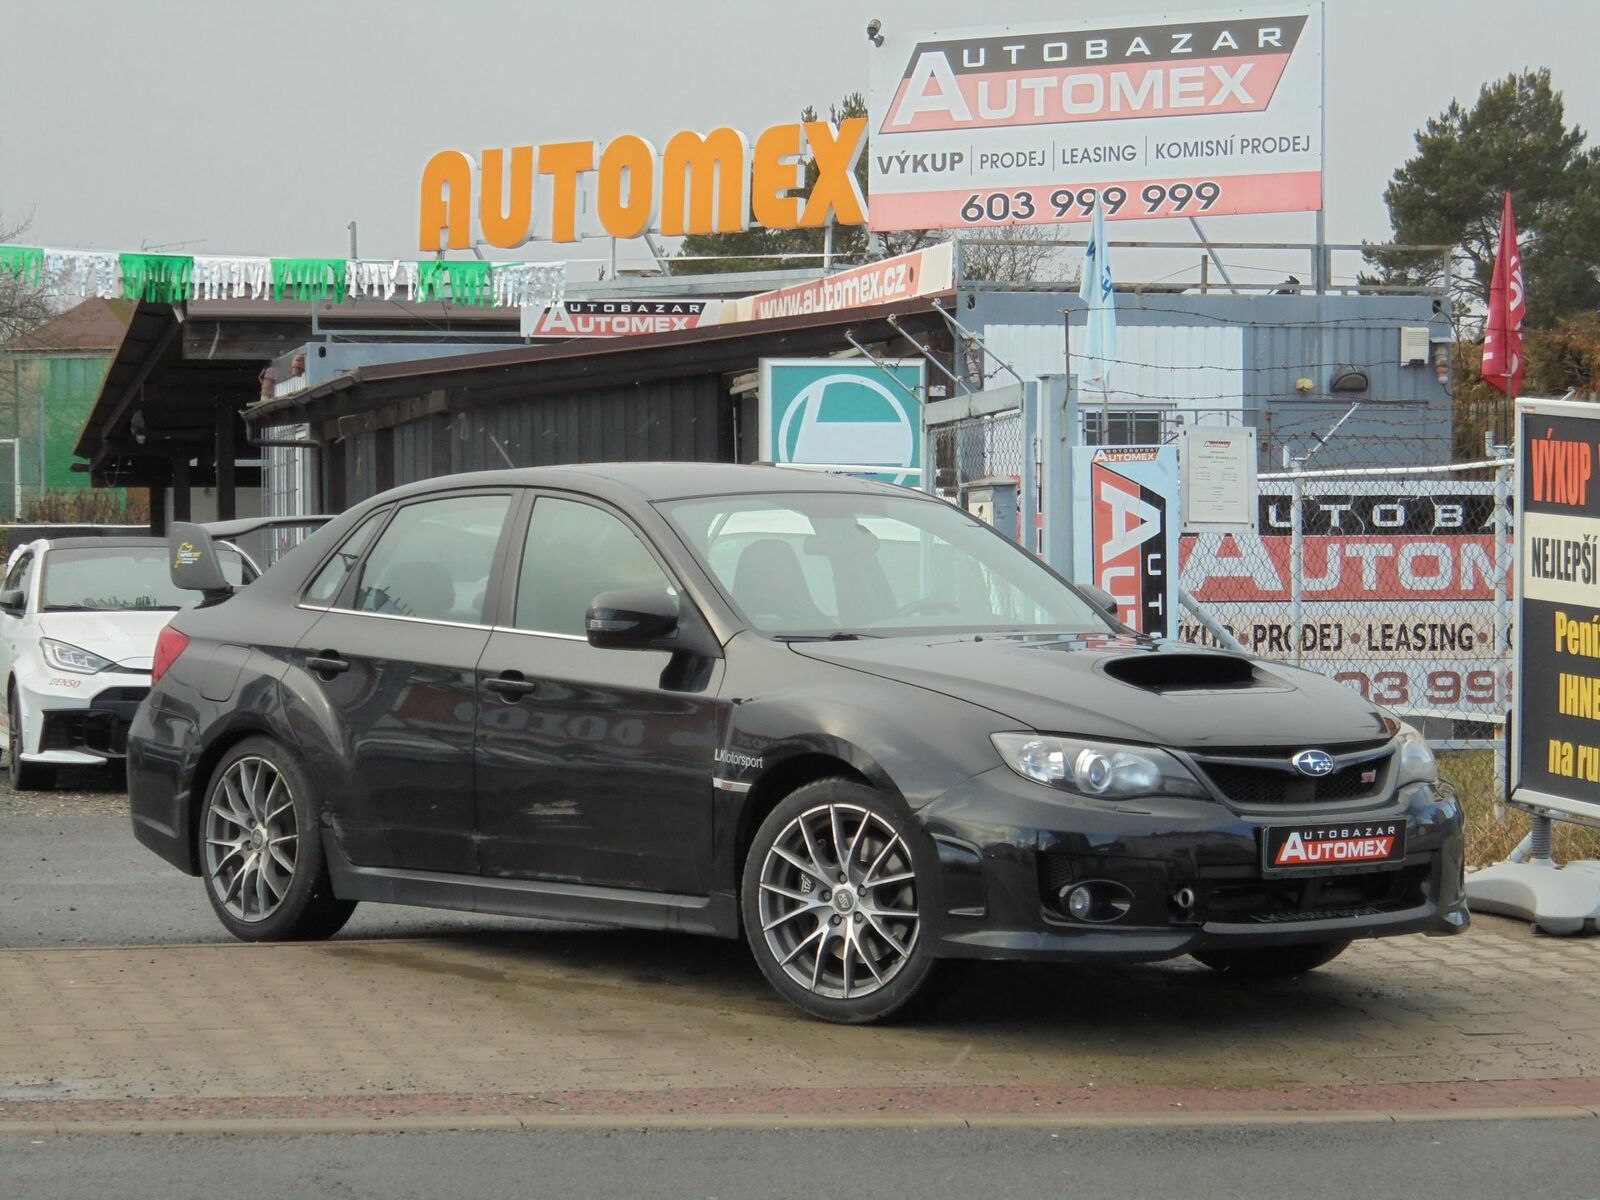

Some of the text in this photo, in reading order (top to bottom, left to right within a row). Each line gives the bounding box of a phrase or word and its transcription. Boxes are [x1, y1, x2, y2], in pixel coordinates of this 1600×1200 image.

[891, 50, 1255, 126] AUTOMEX
[877, 134, 1312, 176] VÝKUP PRODEJ LEASING KOMISNÍ PRODEJ
[419, 117, 869, 252] AUTOMEX
[960, 181, 1221, 223] 603 999 999
[759, 263, 907, 319] www.automex.cz
[540, 300, 691, 334] AUTOMEX
[1092, 449, 1155, 462] AUTOMEX
[1531, 428, 1591, 506] VÝKUP
[1531, 533, 1599, 585] NEJLEPŠÍ
[1253, 624, 1343, 652] PRODEJ
[1367, 623, 1474, 652] LEASING
[1554, 611, 1600, 658] Pení
[1426, 670, 1513, 705] 99
[1548, 738, 1600, 783] na ru
[1280, 831, 1389, 862] AUTOMEX
